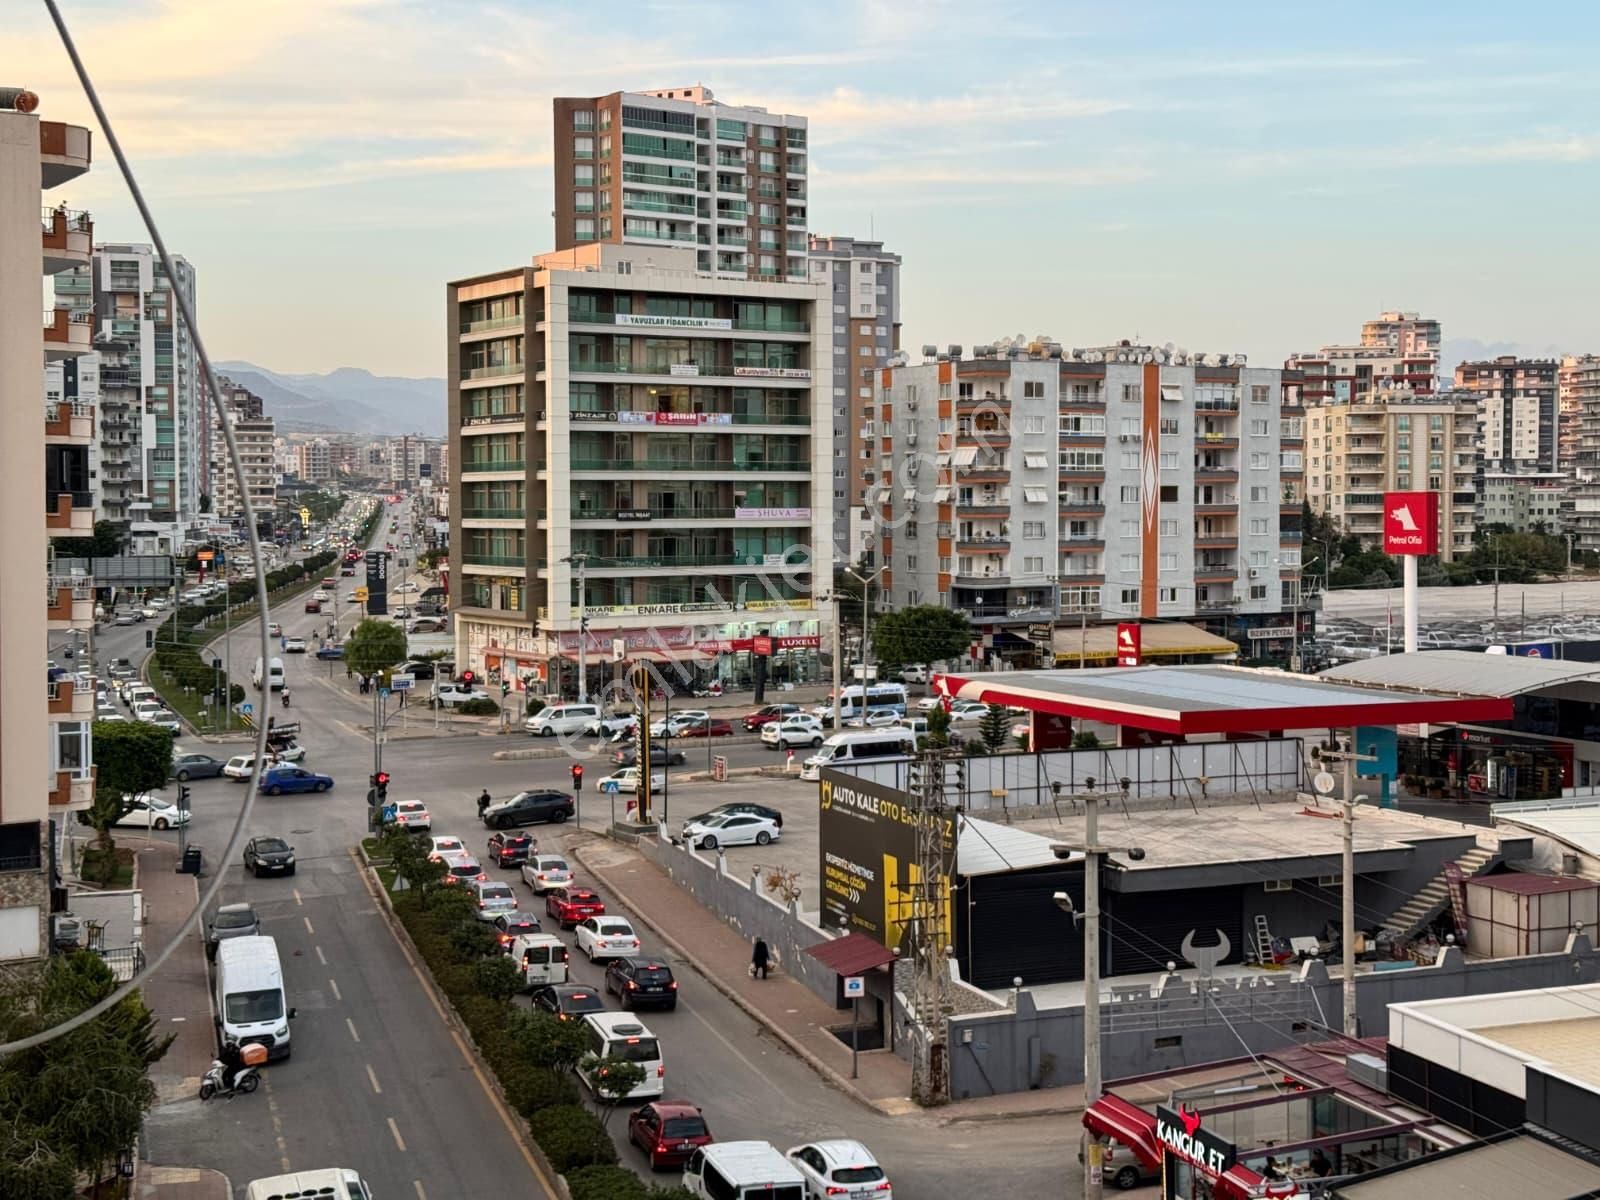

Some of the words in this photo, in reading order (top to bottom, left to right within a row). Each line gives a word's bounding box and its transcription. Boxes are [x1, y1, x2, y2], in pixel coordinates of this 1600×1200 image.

[630, 316, 665, 326] YAVUZLAR
[758, 509, 792, 517] SHUVA
[1388, 535, 1407, 545] Petrol
[637, 604, 680, 615] ENKARE
[781, 638, 819, 648] LUXELL
[833, 785, 856, 806] AUTO
[856, 792, 880, 814] KALE
[880, 800, 900, 821] OTO
[1156, 1118, 1206, 1165] KANGUR
[1208, 1147, 1225, 1177] ET
